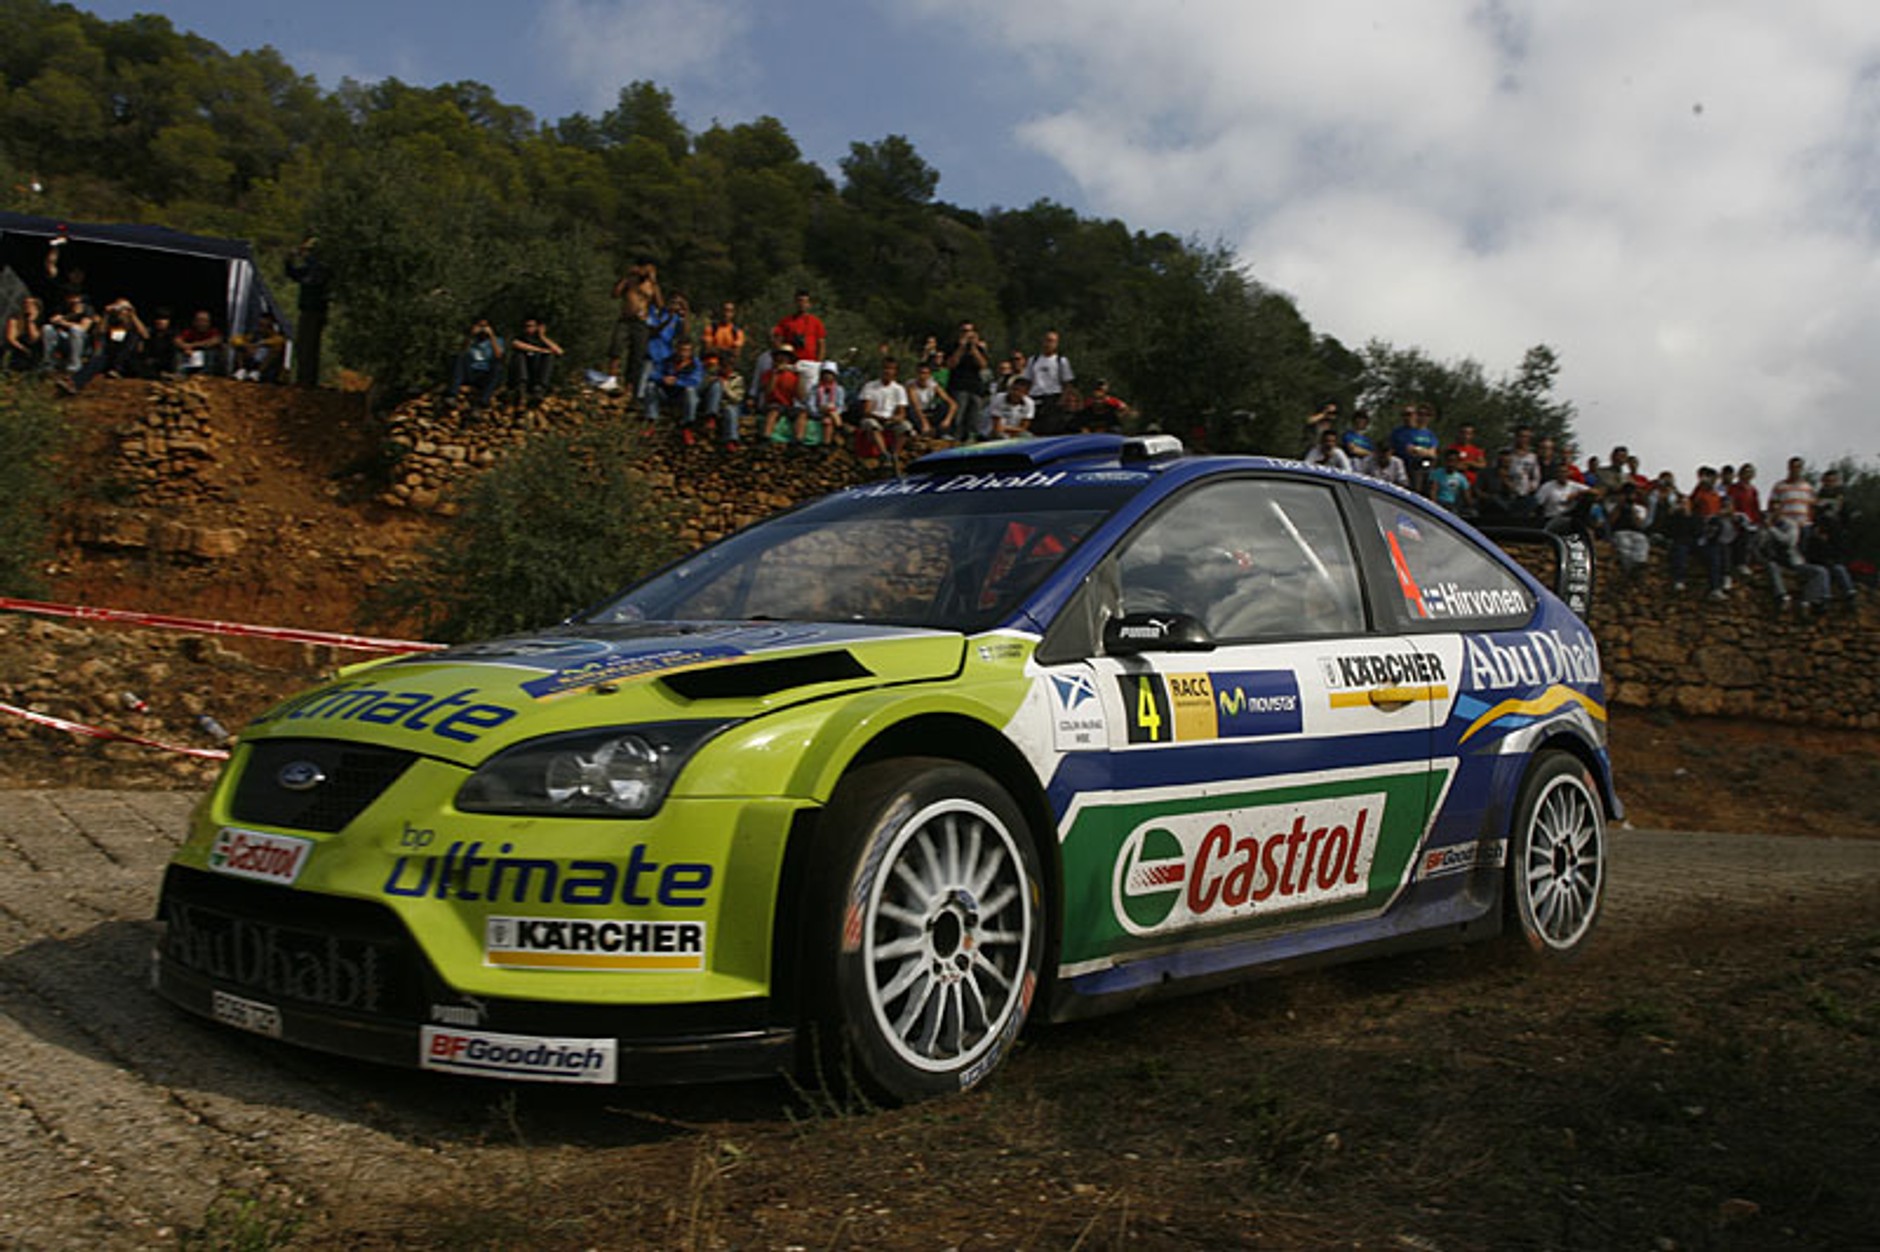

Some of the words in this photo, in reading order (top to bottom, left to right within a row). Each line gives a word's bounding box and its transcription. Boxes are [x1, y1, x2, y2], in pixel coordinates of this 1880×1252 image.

[1438, 582, 1528, 616] Hirvonen
[1337, 653, 1447, 687] KÄRCHER
[1464, 631, 1541, 690] Abu
[1170, 678, 1210, 697] RACC
[1137, 676, 1161, 741] 4
[401, 821, 435, 847] bp
[228, 835, 302, 878] Castrol
[384, 841, 713, 907] ultimate
[1188, 808, 1367, 914] Castrol
[516, 920, 701, 952] KÄRCHER
[430, 1033, 604, 1070] BFGoodrich
